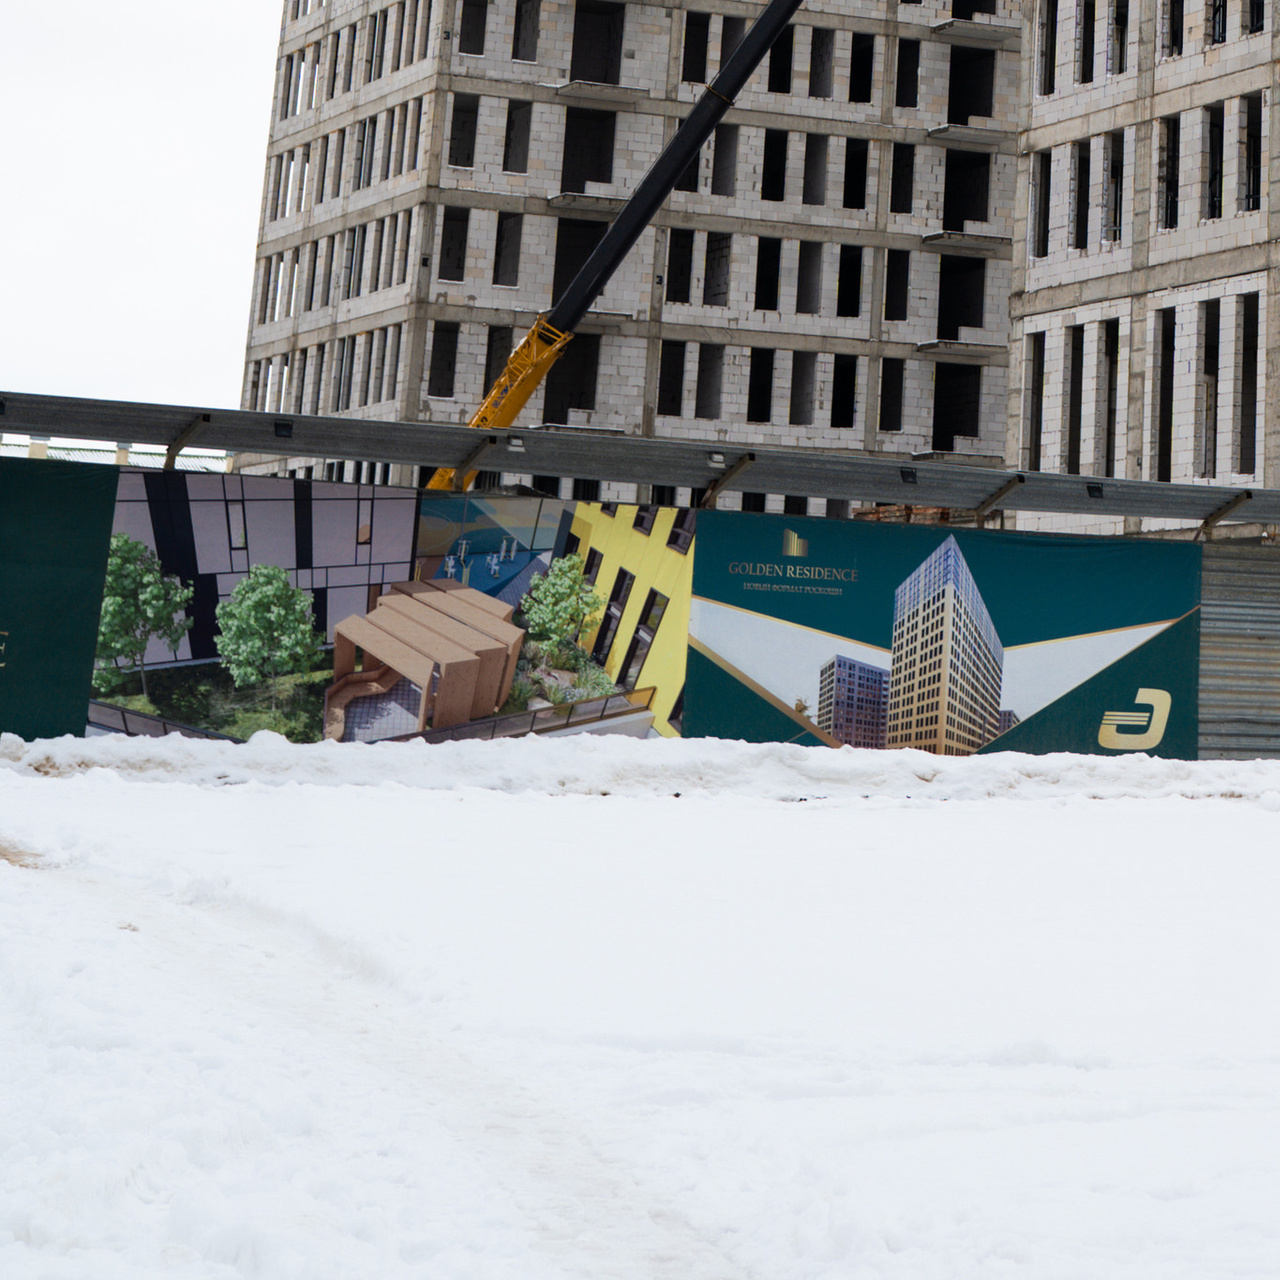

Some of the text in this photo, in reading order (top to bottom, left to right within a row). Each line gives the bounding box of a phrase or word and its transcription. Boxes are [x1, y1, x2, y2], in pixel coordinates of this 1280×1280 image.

[728, 561, 859, 582] GOLDEN RESIDENCE
[771, 583, 803, 593] ФОРМАТ
